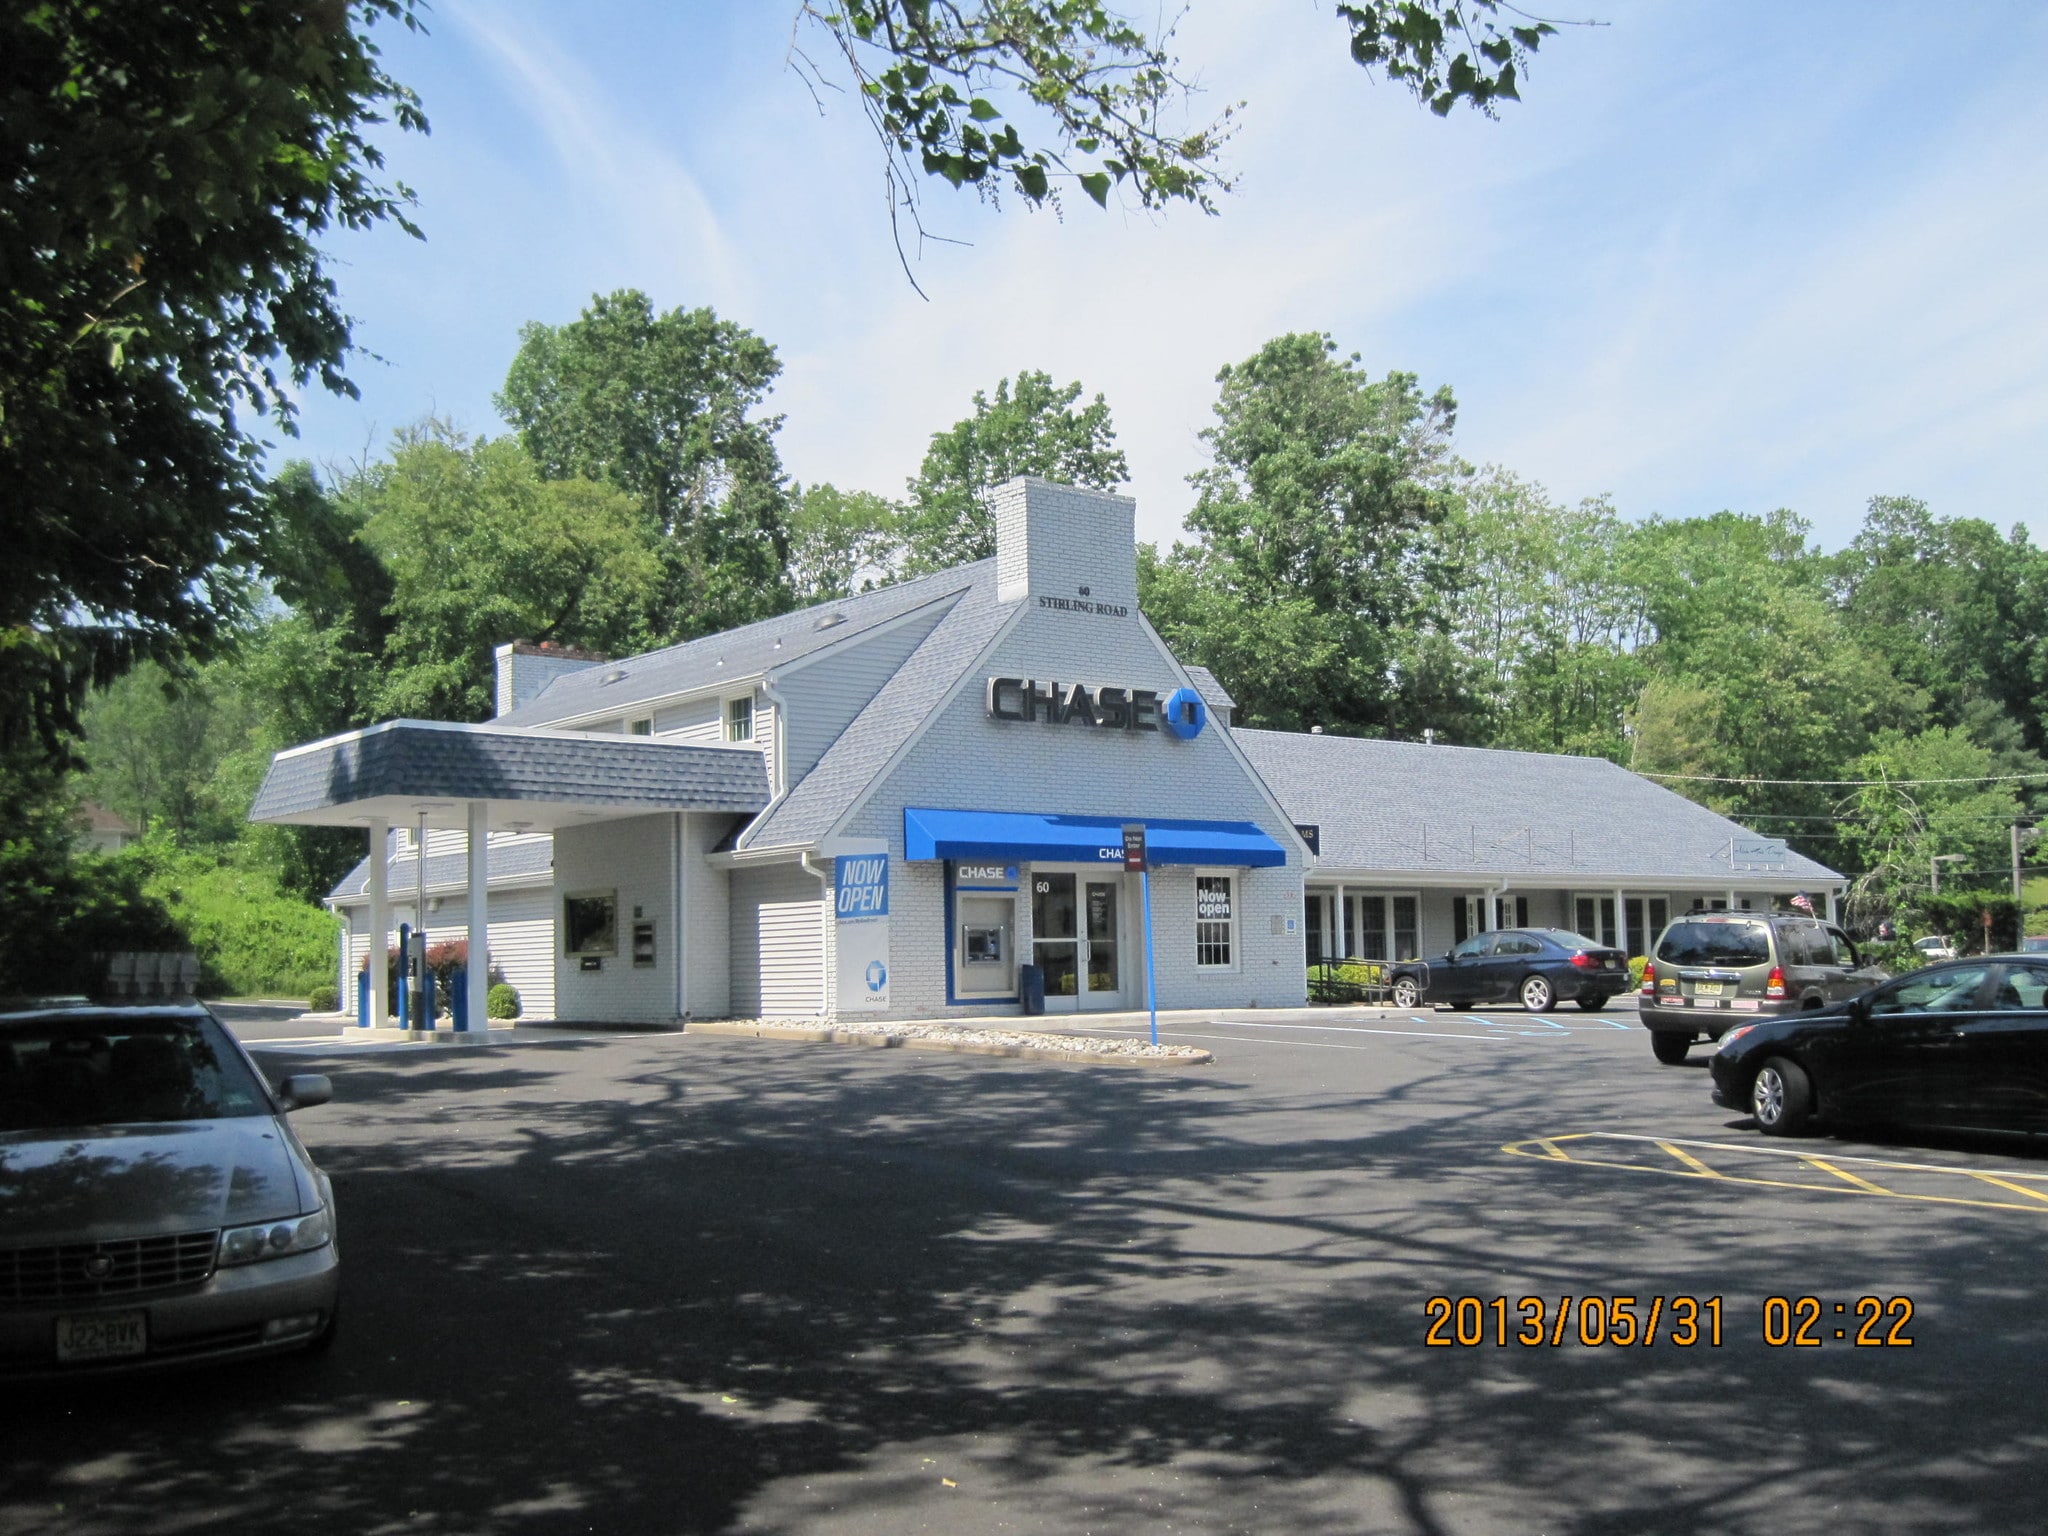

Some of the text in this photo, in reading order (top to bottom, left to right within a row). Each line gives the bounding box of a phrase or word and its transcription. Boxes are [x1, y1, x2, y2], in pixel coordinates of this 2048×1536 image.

[1078, 586, 1090, 597] 60
[1039, 596, 1128, 617] STIRLING ROAD
[987, 677, 1160, 731] CHASE
[1098, 848, 1125, 859] CHA
[842, 859, 885, 886] NOW
[959, 866, 1005, 879] CHASE
[1036, 881, 1050, 893] 60
[838, 885, 884, 913] OPEN
[1198, 889, 1227, 903] Now
[1198, 903, 1230, 917] open
